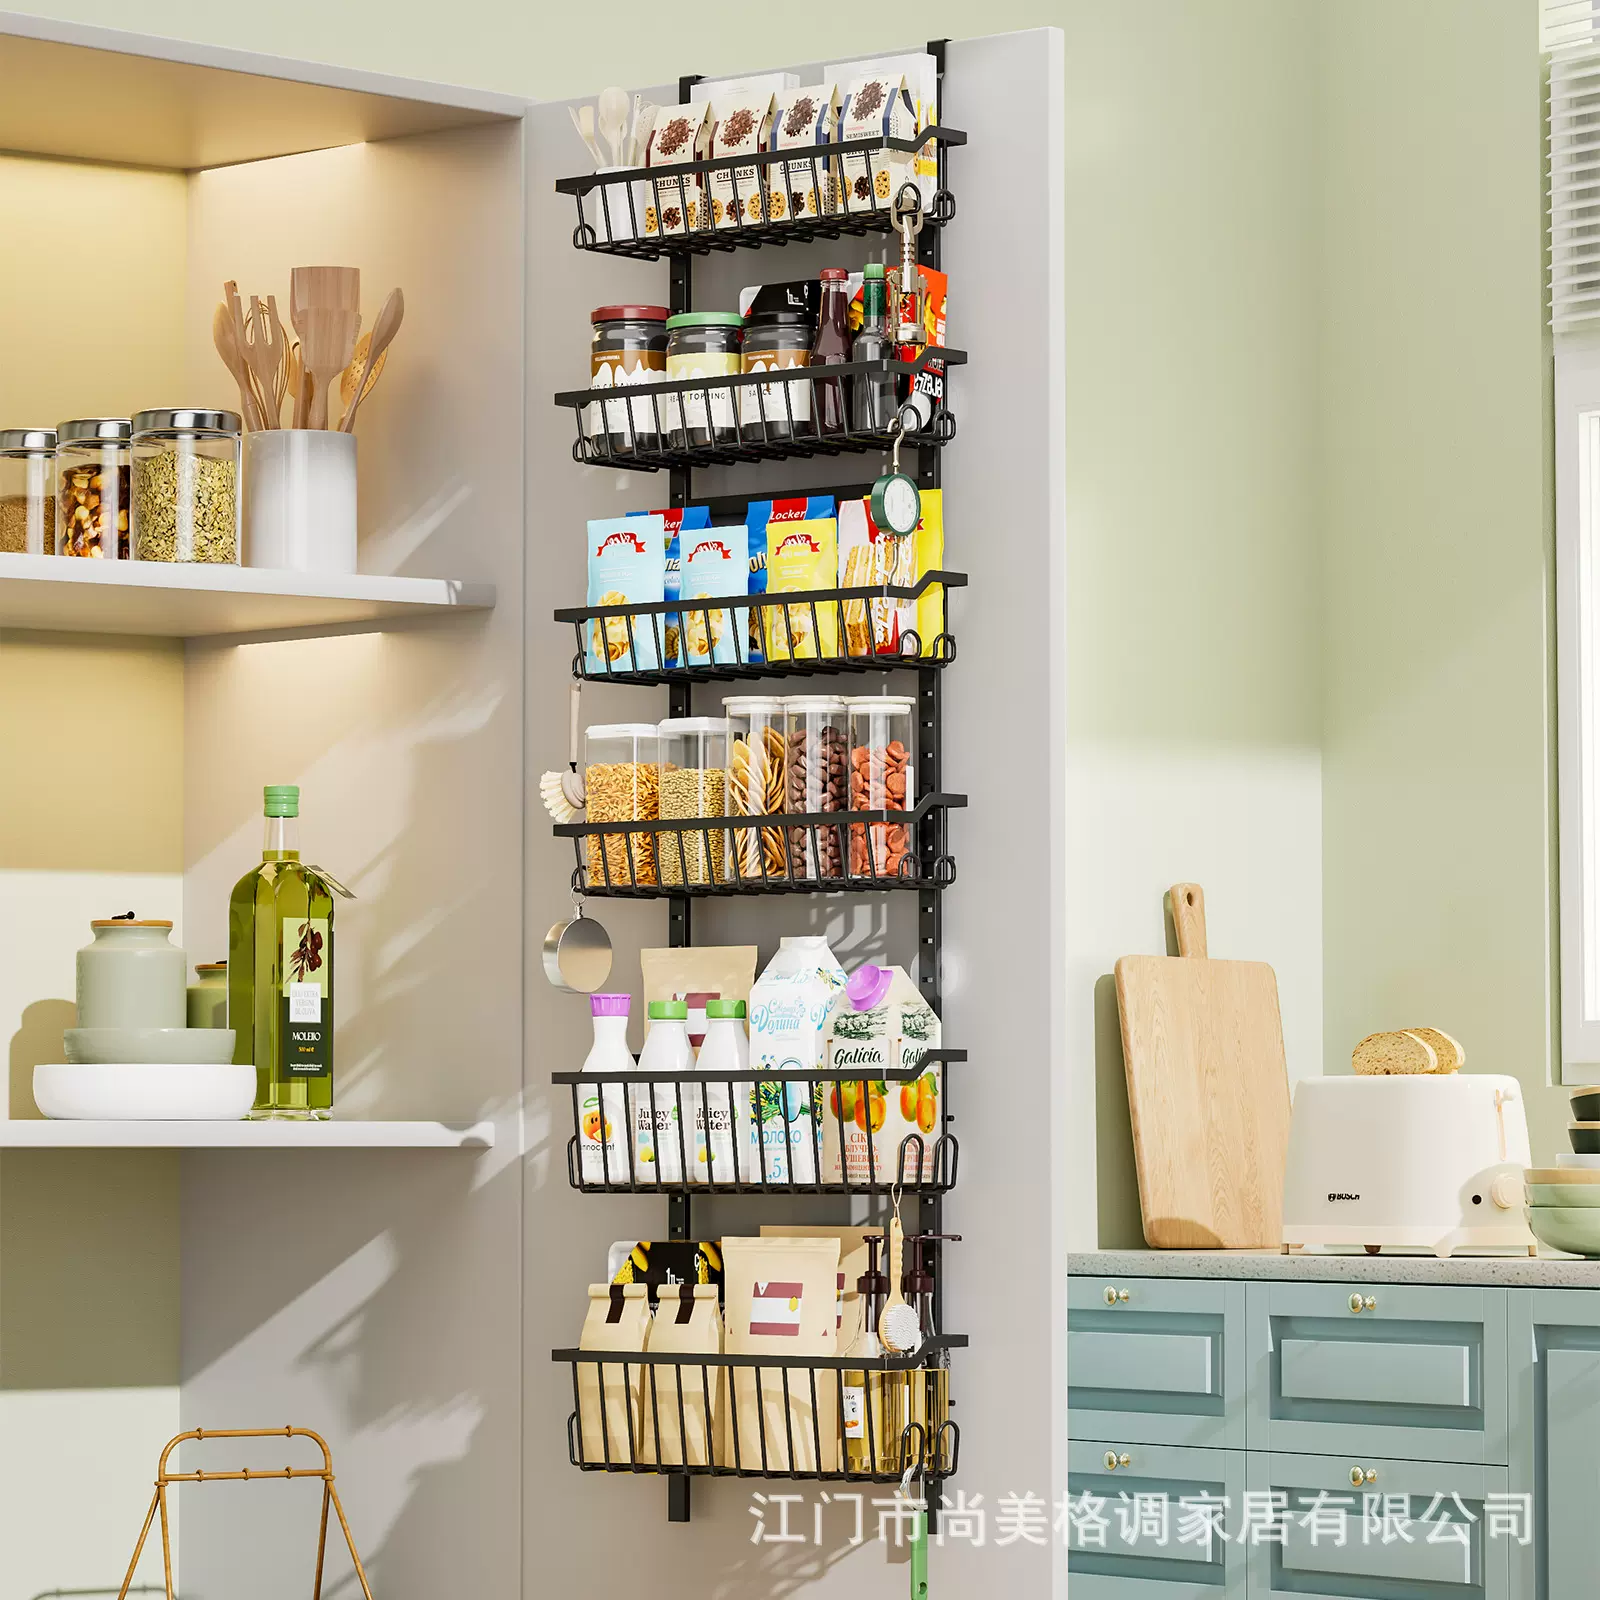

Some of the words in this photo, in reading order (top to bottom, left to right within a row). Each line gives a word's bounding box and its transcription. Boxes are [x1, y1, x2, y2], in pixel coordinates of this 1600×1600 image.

[716, 168, 755, 180] CHNKS
[655, 176, 691, 187] HUNS
[689, 392, 726, 401] TOPING
[748, 388, 772, 398] SACE
[833, 1047, 885, 1070] Galicia
[638, 1108, 670, 1121] Jucy
[696, 1107, 728, 1121] Jicy
[637, 1119, 672, 1131] Waer
[696, 1119, 730, 1131] Wter
